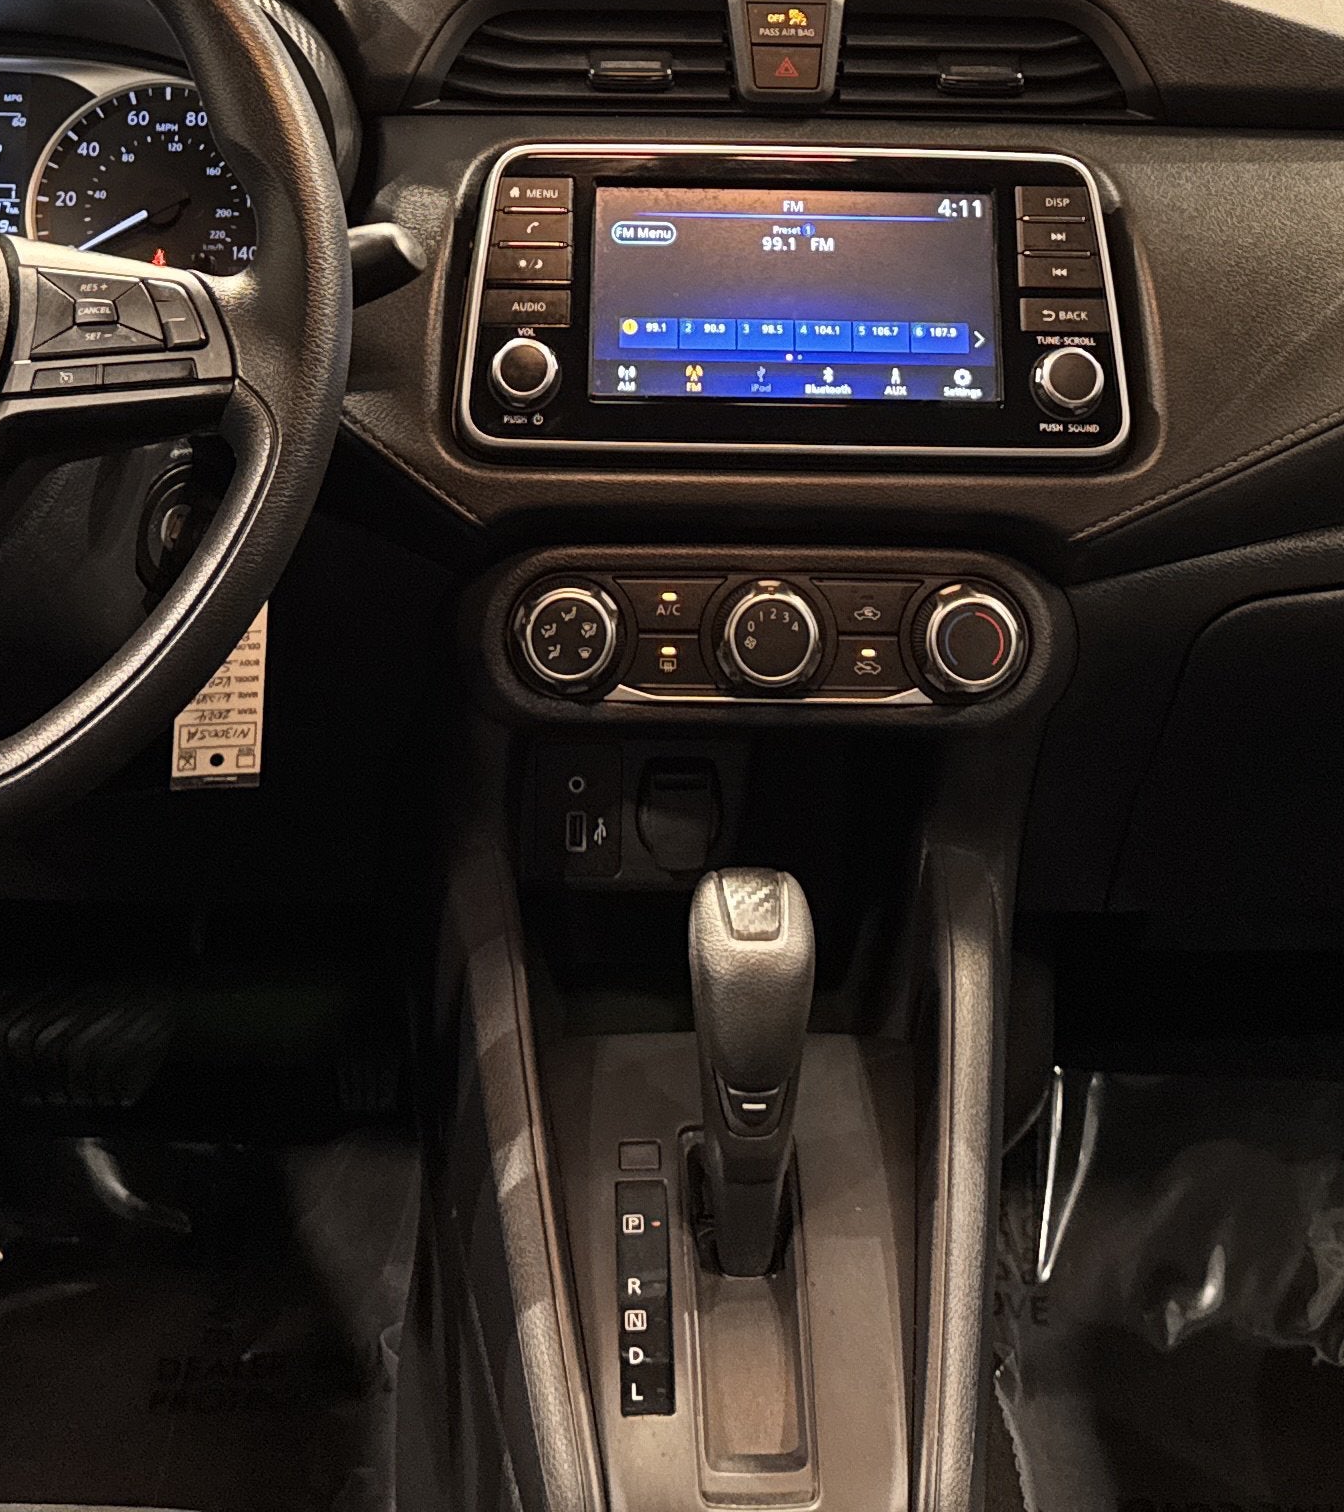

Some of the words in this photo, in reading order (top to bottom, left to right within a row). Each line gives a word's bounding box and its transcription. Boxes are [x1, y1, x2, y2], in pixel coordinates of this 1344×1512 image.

[767, 14, 786, 23] OFF
[759, 27, 780, 36] PASS
[781, 28, 797, 37] AIR
[797, 29, 816, 37] BAG
[3, 93, 23, 102] MPG
[11, 116, 27, 127] 60
[127, 110, 150, 126] 60
[185, 111, 208, 127] 80
[155, 122, 179, 133] MPH
[76, 141, 100, 157] 40
[167, 142, 183, 152] 120
[121, 153, 135, 163] 80
[205, 167, 222, 176] 160
[55, 190, 77, 207] 20
[93, 190, 107, 200] 40
[526, 189, 559, 199] MENU
[783, 201, 804, 213] FM
[1045, 197, 1071, 208] DISP
[215, 208, 233, 218] 200
[937, 198, 983, 219] 4:11
[209, 229, 226, 239] 220
[615, 226, 634, 239] FM
[637, 226, 672, 240] Menu
[772, 225, 801, 236] Preset
[762, 237, 797, 252] 99.1
[810, 238, 835, 252] FM
[80, 283, 98, 292] RES
[77, 306, 112, 316] CANCEL
[511, 301, 547, 312] AUDIO
[1058, 310, 1088, 322] BACK
[517, 327, 536, 337] VOL
[645, 322, 667, 333] 99.1
[761, 324, 784, 335] 98.5
[799, 325, 808, 335] 4
[814, 325, 841, 336] 104.1
[858, 325, 866, 336] 5
[871, 325, 899, 337] 106.7
[85, 332, 102, 341] SET
[617, 381, 637, 392] AM
[686, 382, 703, 392] FM
[751, 382, 772, 393] iPod
[805, 384, 852, 396] Bluetooth
[884, 385, 908, 397] AUX
[943, 386, 983, 399] Settings
[503, 415, 528, 424] PUSH
[1039, 422, 1064, 433] PUSH
[1067, 422, 1100, 434] SOUND
[656, 604, 681, 616] A/C
[747, 621, 755, 632] 0
[759, 611, 764, 622] 1
[770, 608, 777, 619] 2
[782, 612, 790, 623] 3
[791, 621, 799, 632] 4
[627, 1277, 642, 1296] R
[628, 1346, 644, 1365] D
[631, 1382, 644, 1401] L
